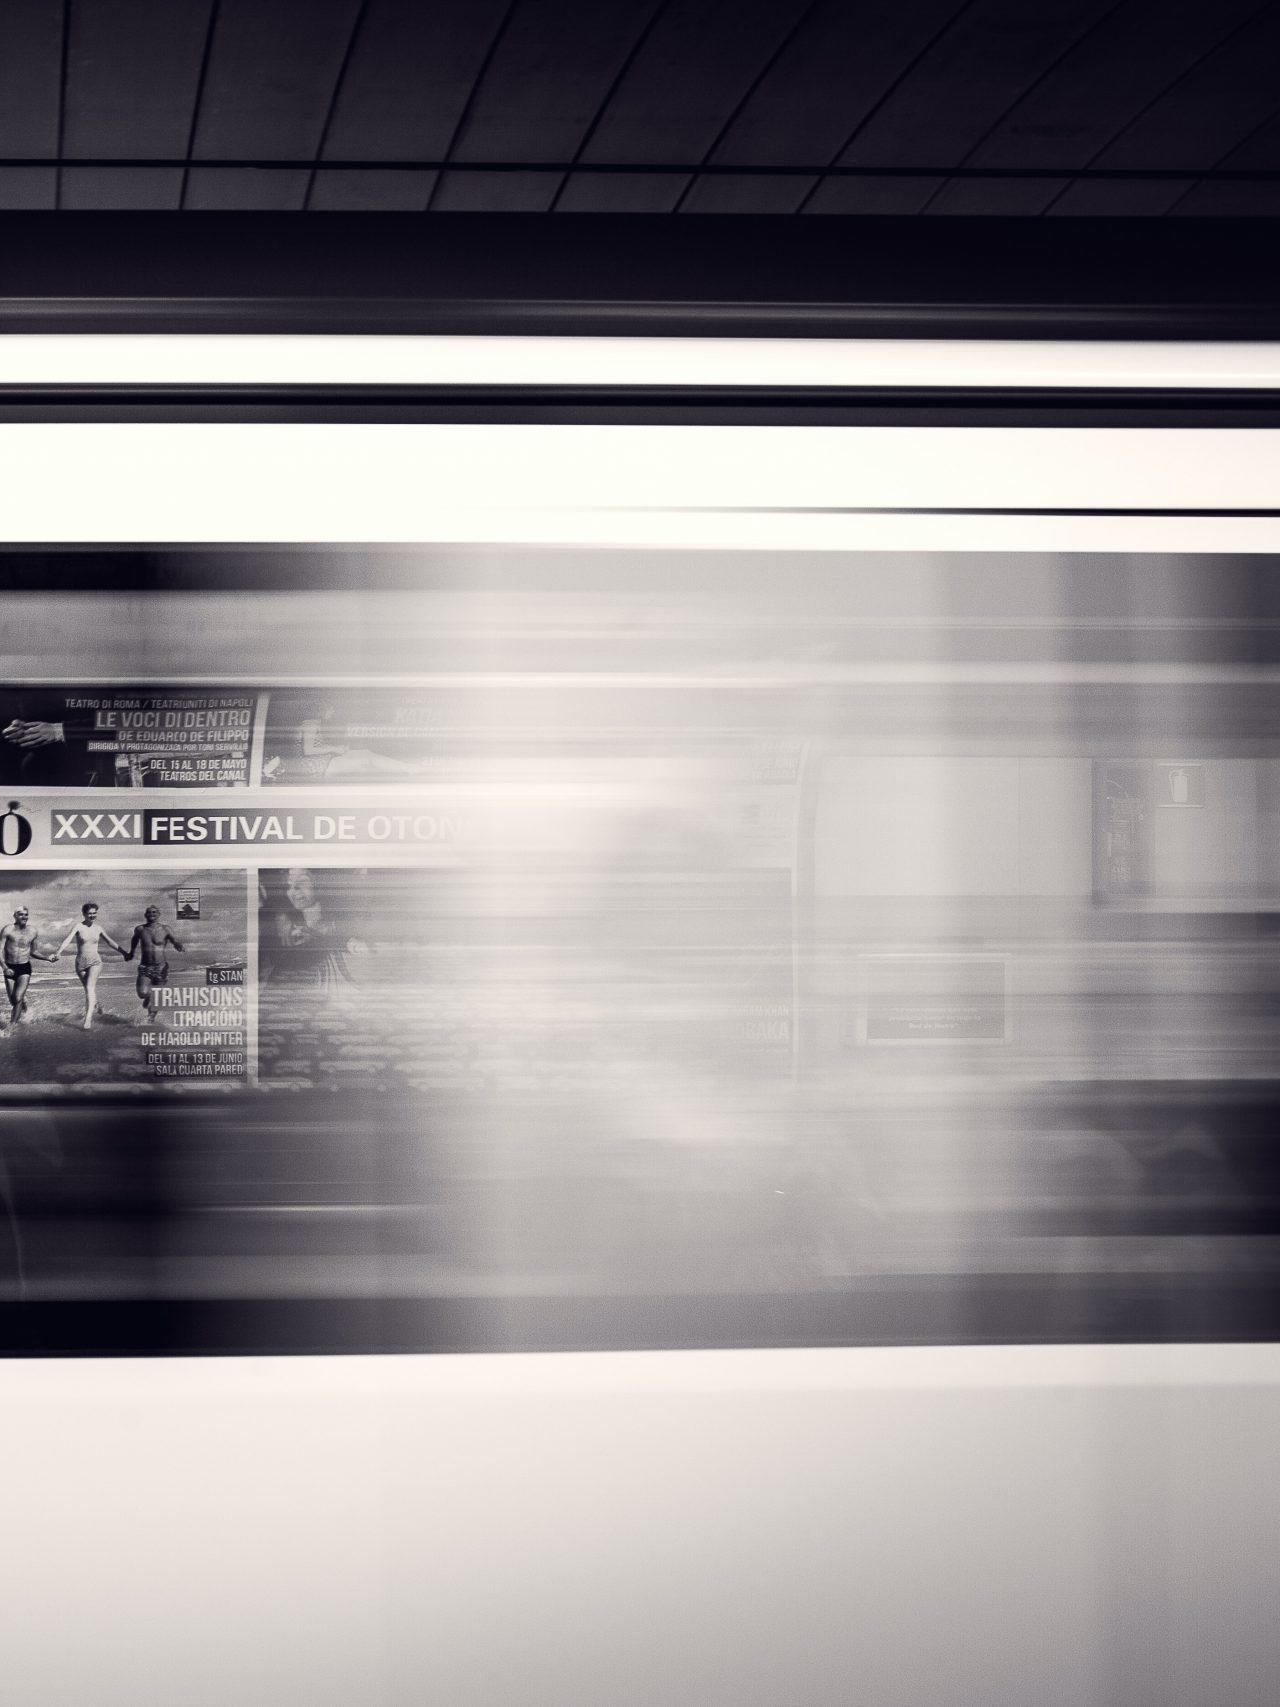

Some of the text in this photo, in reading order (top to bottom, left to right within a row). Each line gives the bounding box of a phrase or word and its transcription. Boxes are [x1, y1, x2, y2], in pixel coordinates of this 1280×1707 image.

[65, 699, 100, 709] TEATRO
[113, 699, 140, 709] ROMA
[96, 710, 251, 728] LE VOCI DI DENTRO
[119, 729, 249, 742] DE EDUARDO DE FILIPPO
[150, 759, 167, 769] DEL
[181, 759, 193, 769] AL
[196, 759, 207, 769] 18
[207, 759, 221, 769] DE
[221, 758, 247, 769] MAYO
[160, 770, 247, 781] TEATROS DEL CANAL
[54, 814, 142, 839] XXXI
[150, 815, 304, 841] FESTIVAL
[314, 815, 357, 841] DE
[209, 970, 243, 984] tg STAN
[151, 987, 243, 1007] TRAHISONS
[141, 1031, 244, 1046] DE HAROLD PINTER
[148, 1053, 165, 1064] DEL
[178, 1053, 189, 1064] AL
[193, 1053, 204, 1064] 13
[205, 1053, 217, 1063] DE
[218, 1052, 243, 1063] JUNIO
[156, 1064, 243, 1076] SALA CUARTA PARED
